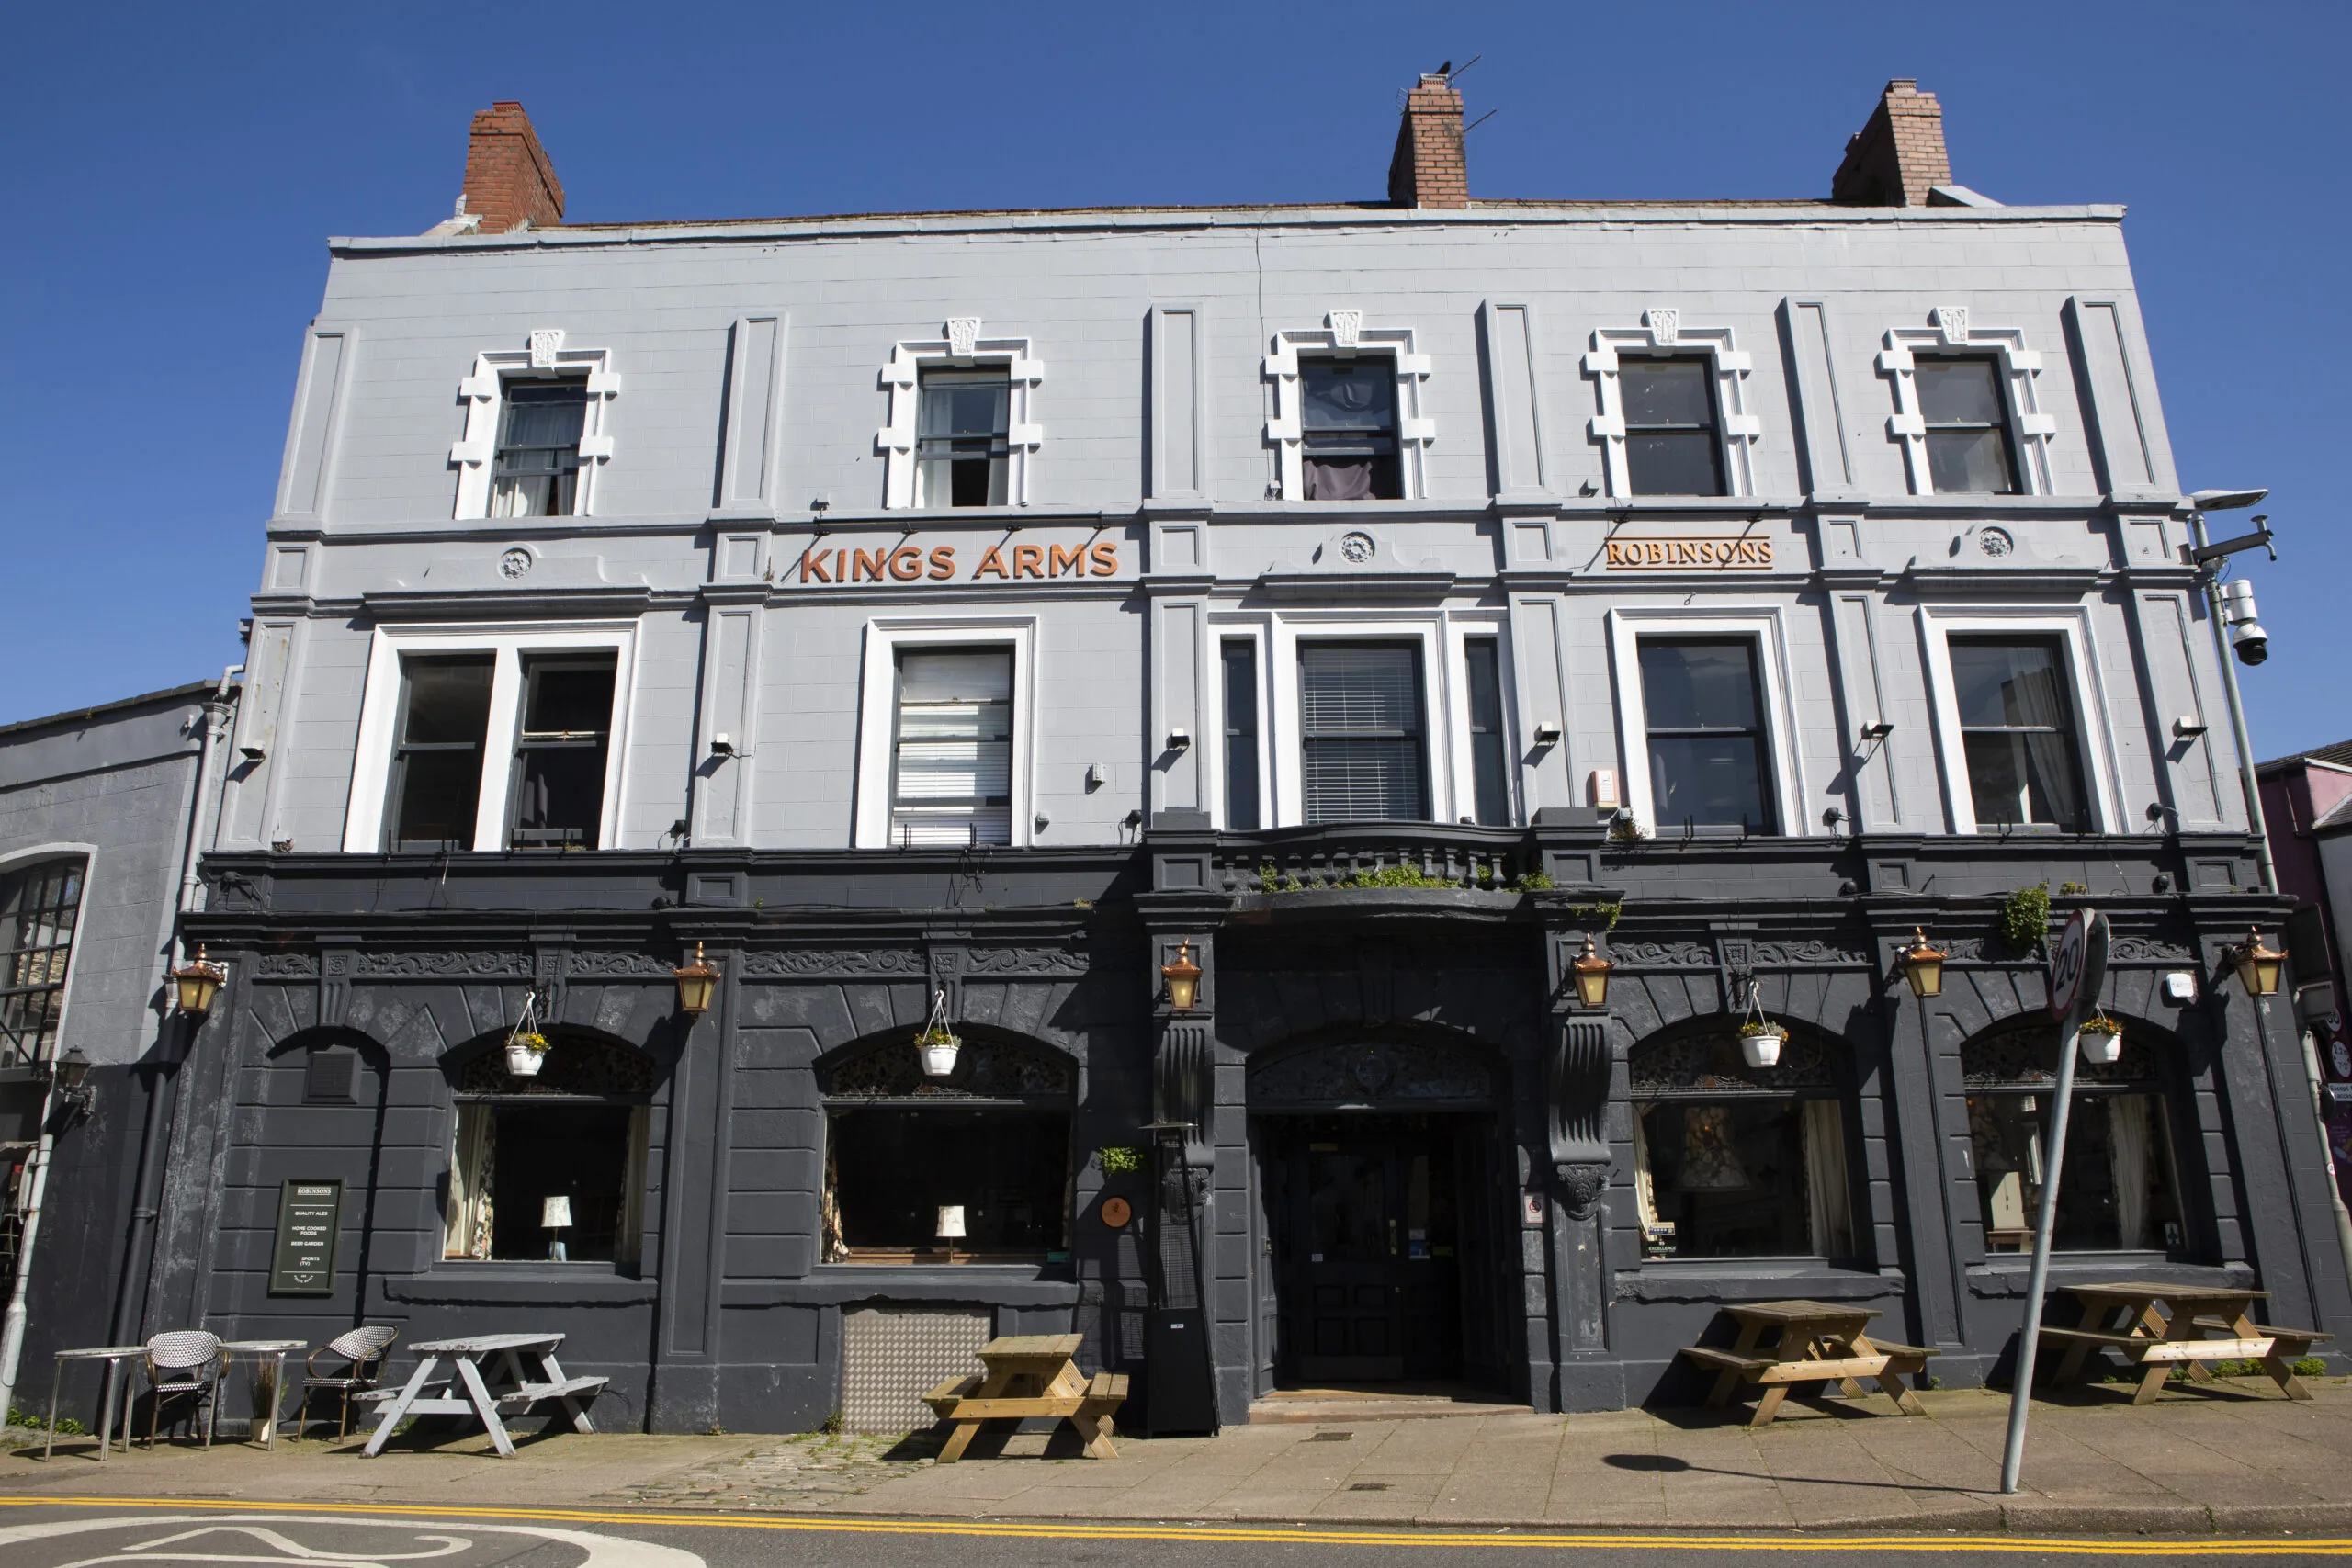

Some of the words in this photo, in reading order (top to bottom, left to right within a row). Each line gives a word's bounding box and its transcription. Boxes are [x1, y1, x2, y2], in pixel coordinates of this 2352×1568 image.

[800, 546, 956, 582] KINGS
[973, 542, 1119, 580] ARMS
[1606, 541, 1774, 566] ROBINSONS
[2055, 937, 2079, 992] 20
